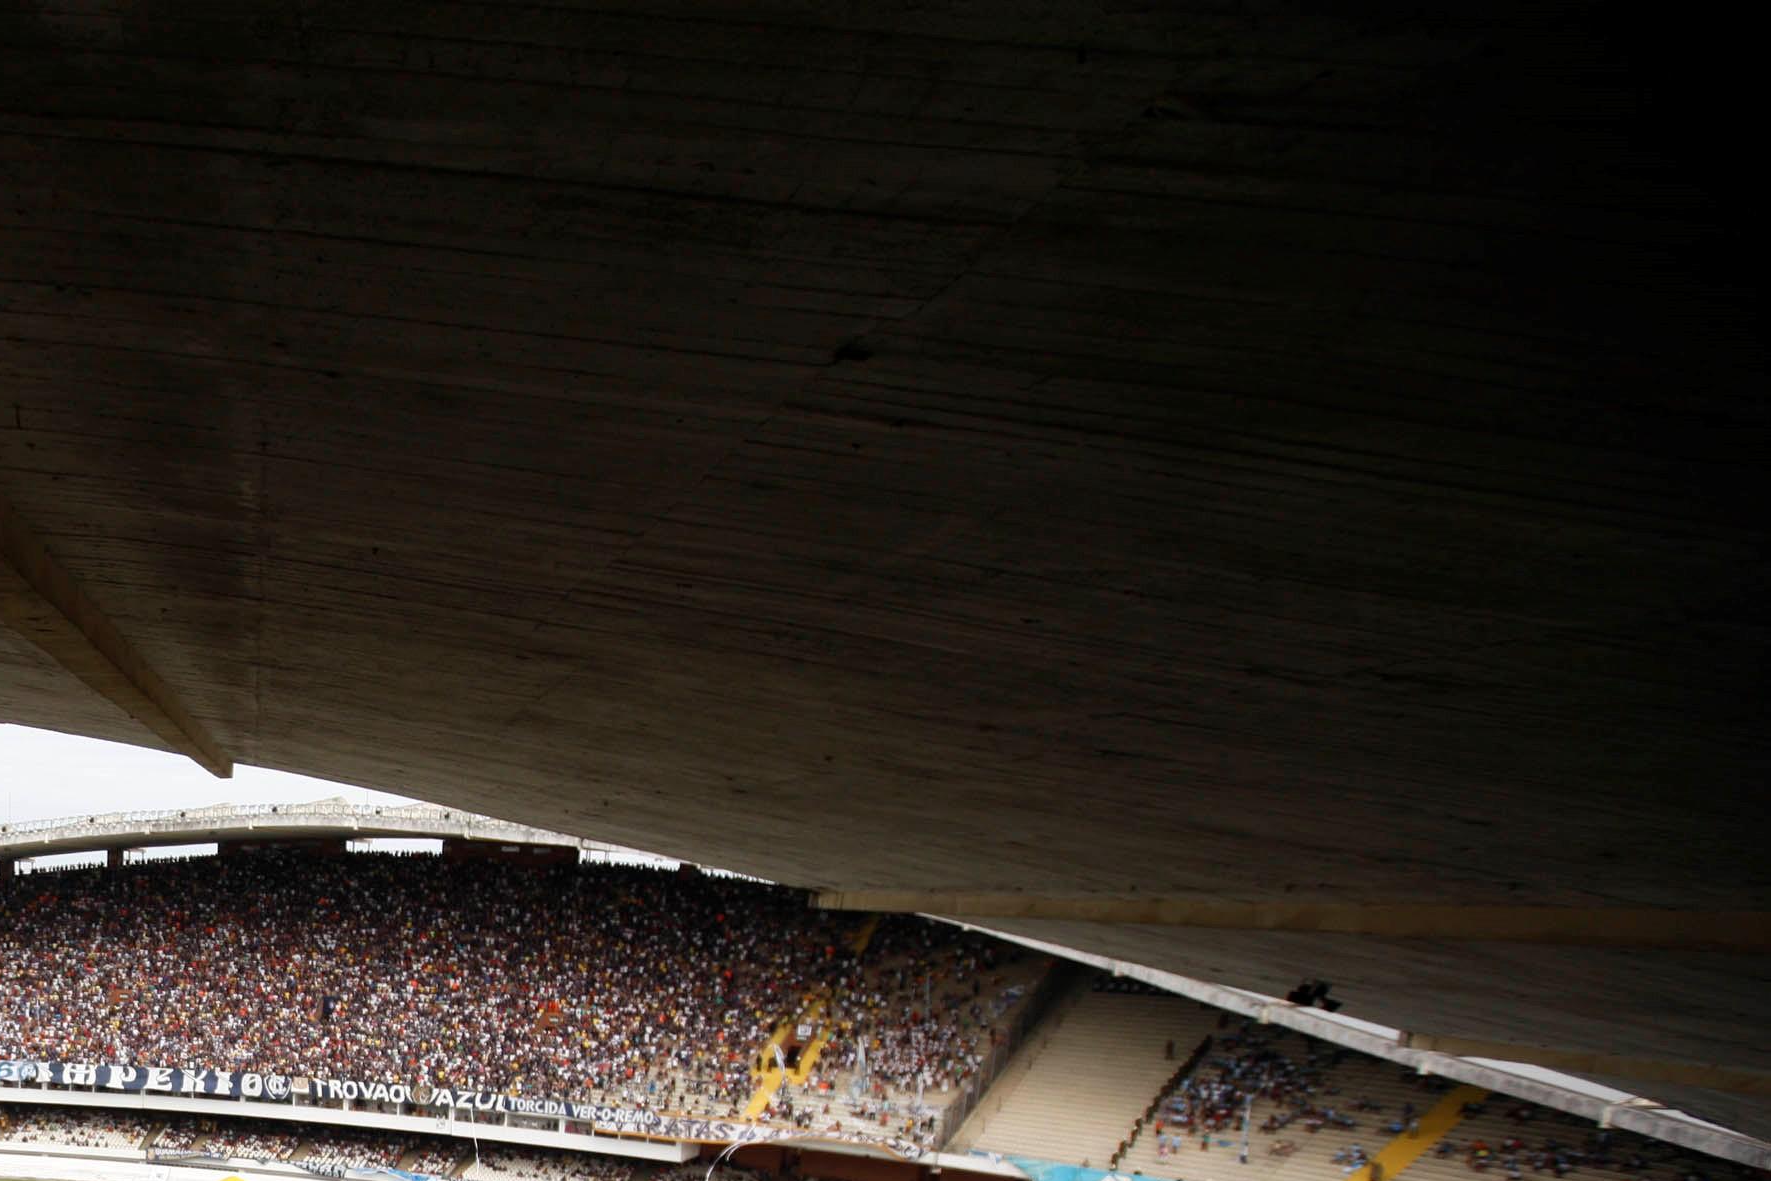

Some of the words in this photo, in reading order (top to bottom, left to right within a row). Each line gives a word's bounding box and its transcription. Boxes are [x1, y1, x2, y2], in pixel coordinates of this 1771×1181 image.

[434, 1087, 507, 1112] AZUL
[509, 1100, 566, 1117] TORCIDA
[572, 1104, 654, 1124] VER-O-REMO
